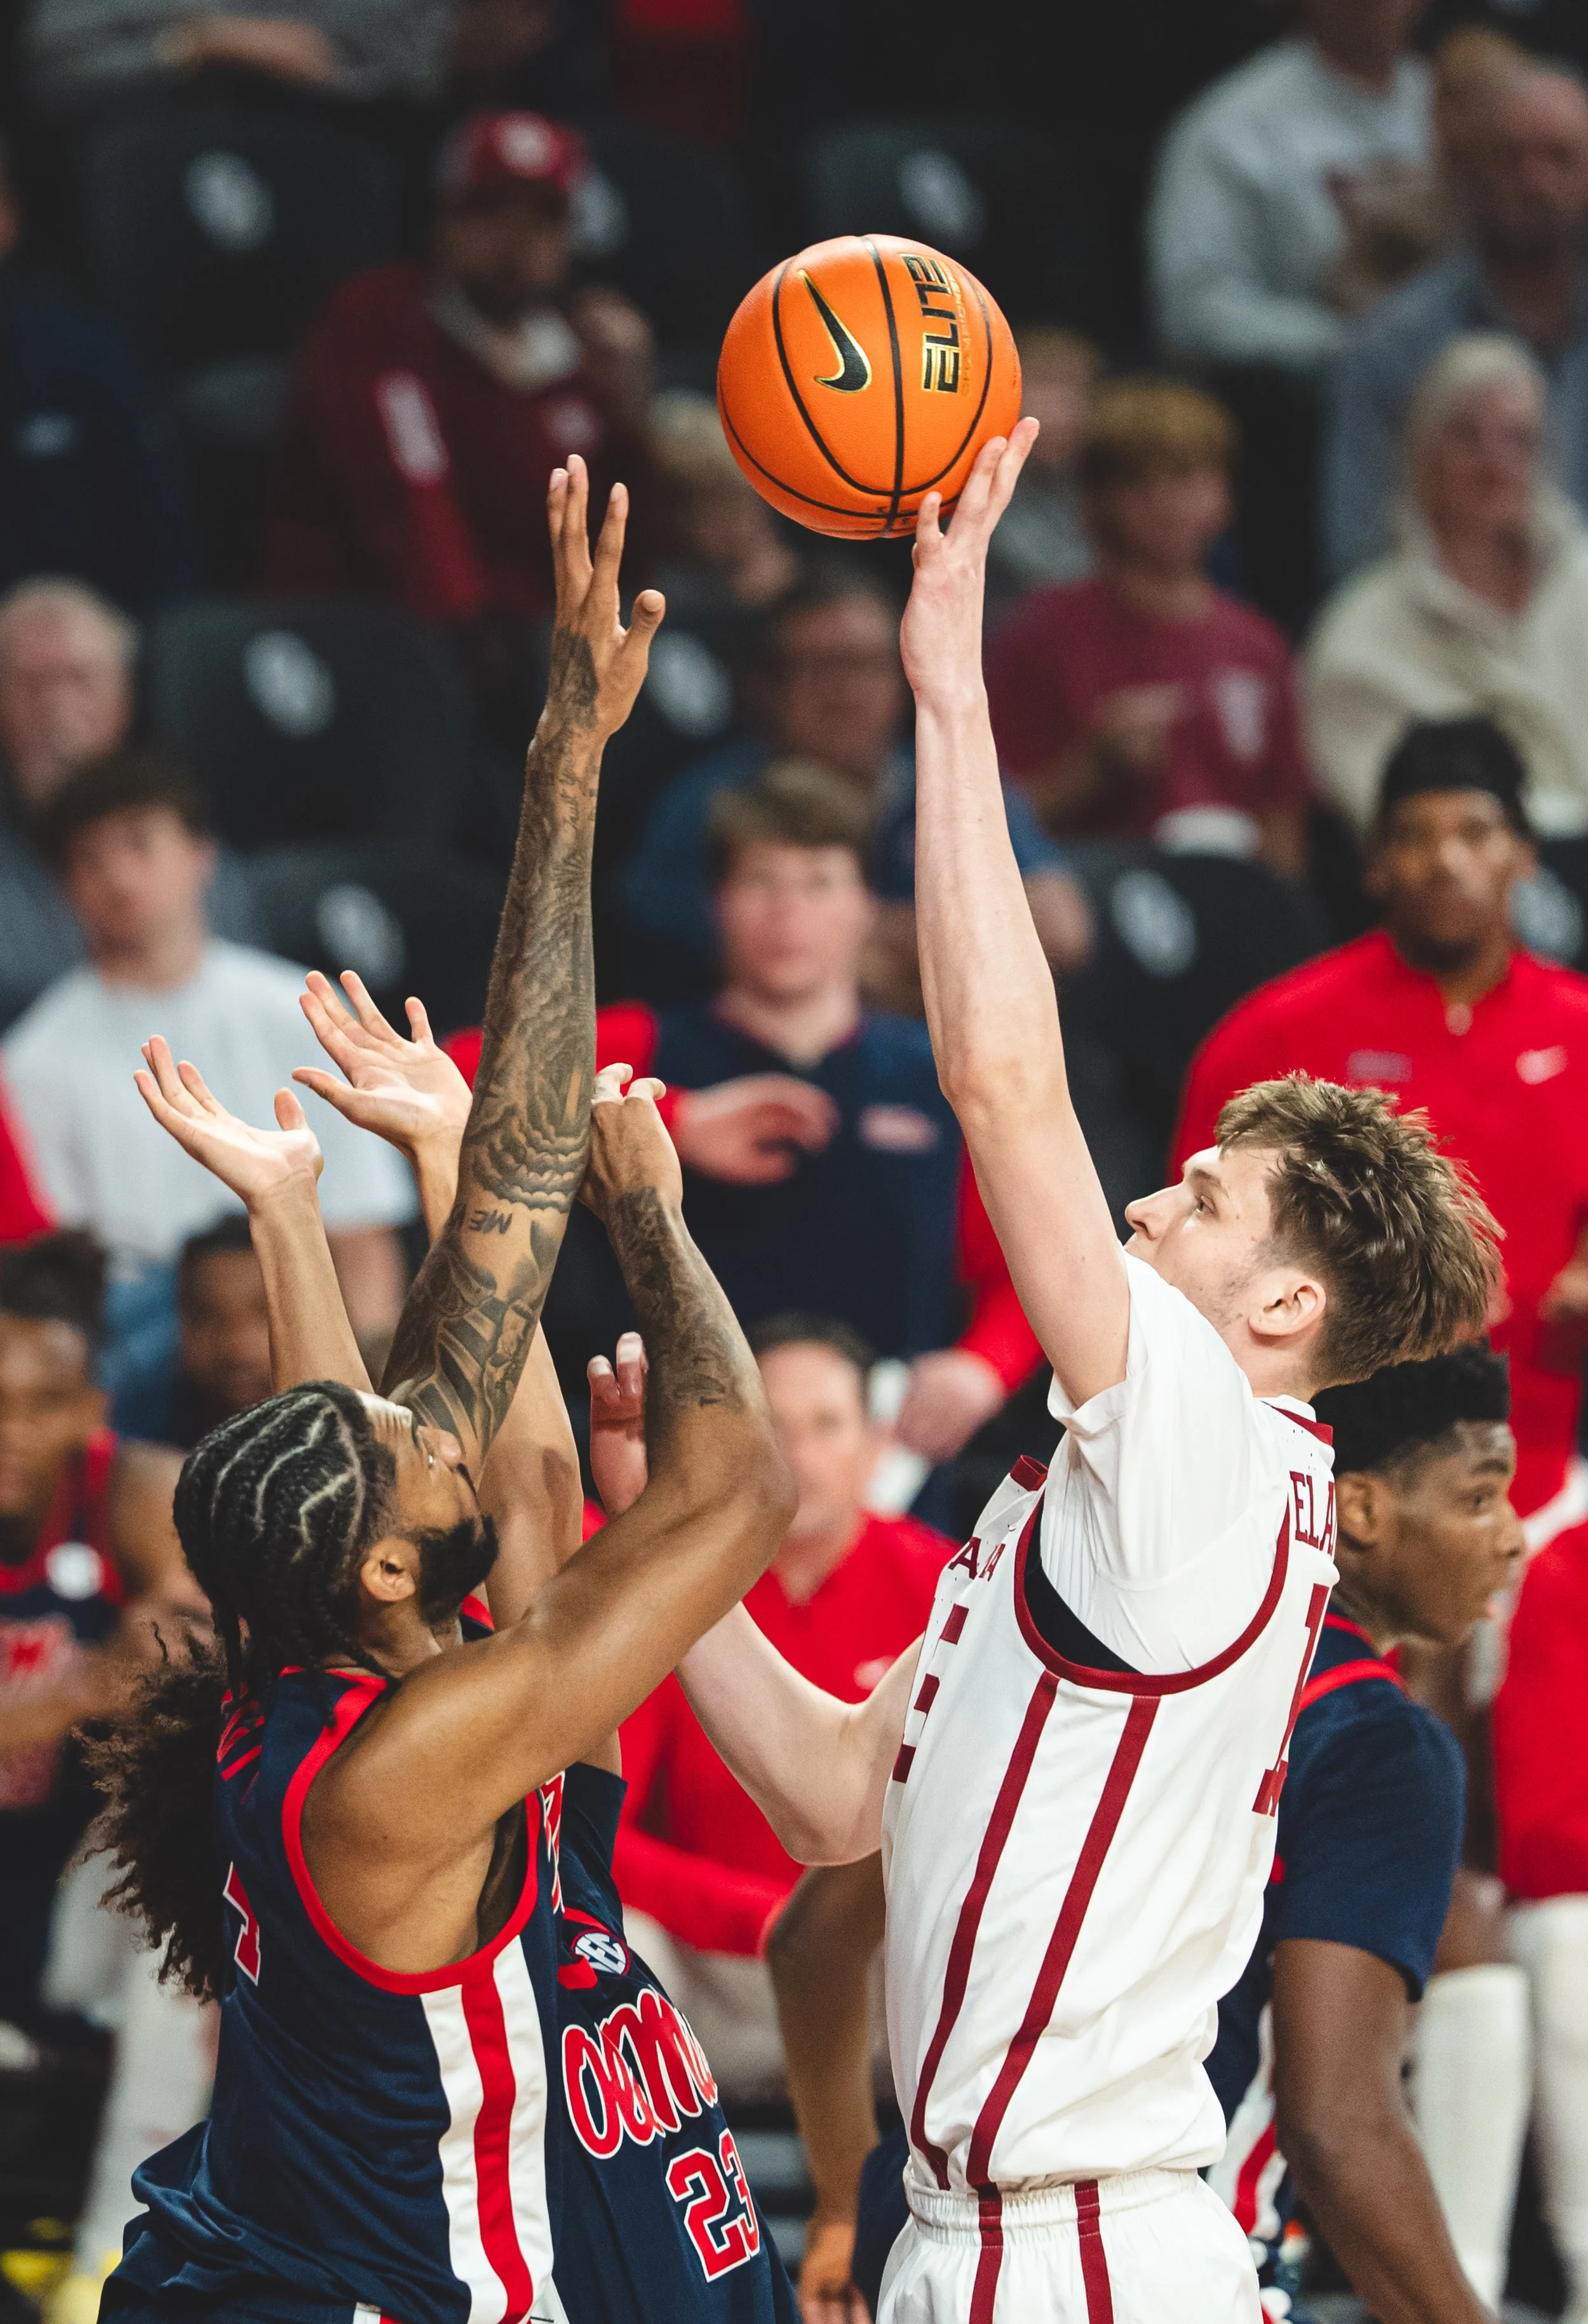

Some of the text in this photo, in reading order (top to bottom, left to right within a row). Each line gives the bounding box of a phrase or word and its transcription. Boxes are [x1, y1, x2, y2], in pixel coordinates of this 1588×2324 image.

[900, 253, 961, 394] ELITE
[1289, 1470, 1338, 1556] ELA
[665, 2128, 760, 2282] 23
